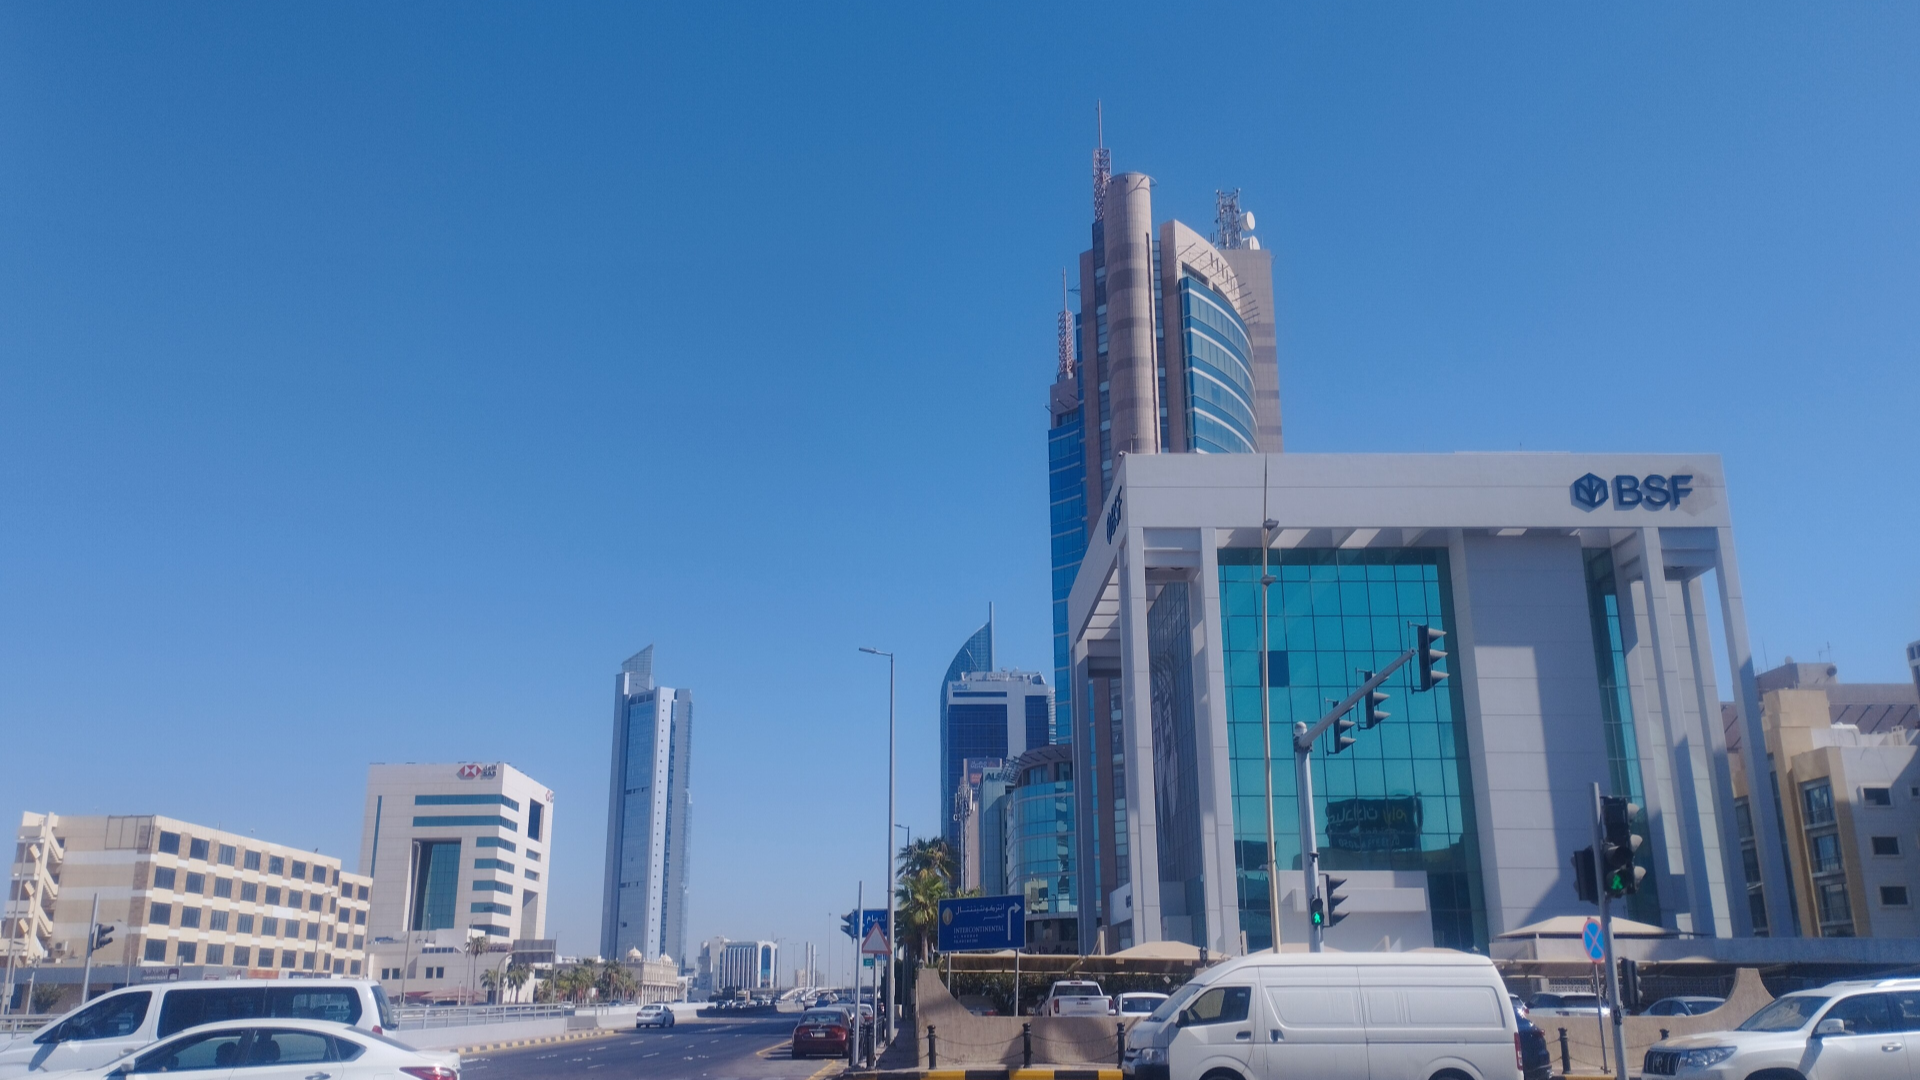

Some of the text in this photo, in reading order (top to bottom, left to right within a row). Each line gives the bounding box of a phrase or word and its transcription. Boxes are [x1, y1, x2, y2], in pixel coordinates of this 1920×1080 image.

[1614, 474, 1693, 507] BSF
[866, 914, 887, 925] لدمام
[953, 925, 1004, 934] INTERCONTINENTAL
